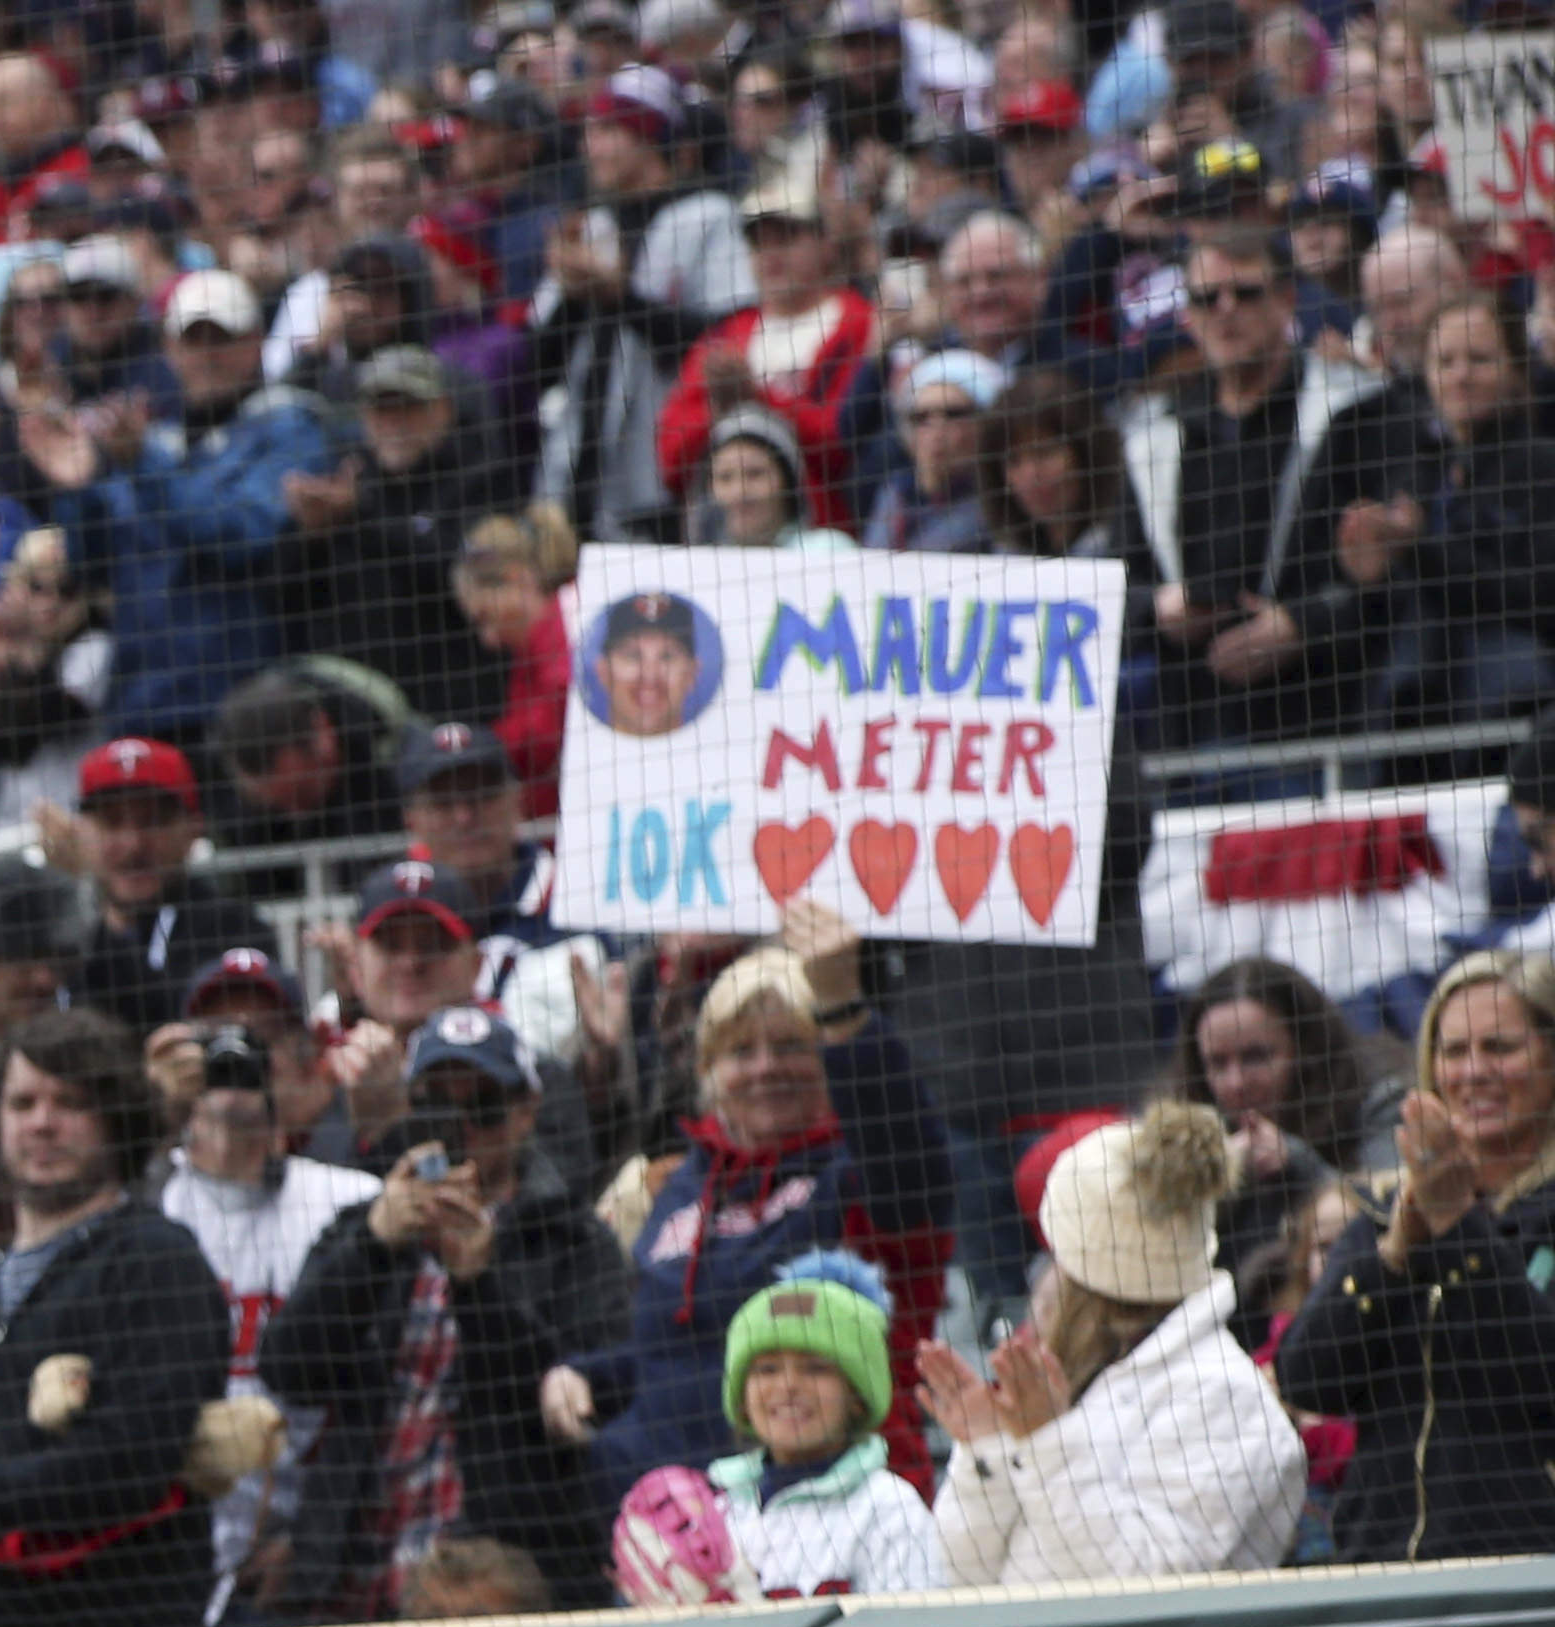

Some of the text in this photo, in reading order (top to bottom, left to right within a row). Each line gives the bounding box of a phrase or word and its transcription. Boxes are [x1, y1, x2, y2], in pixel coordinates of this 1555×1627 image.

[755, 591, 1099, 708] MAUER
[761, 716, 1055, 797] METER
[603, 800, 732, 907] 10K
